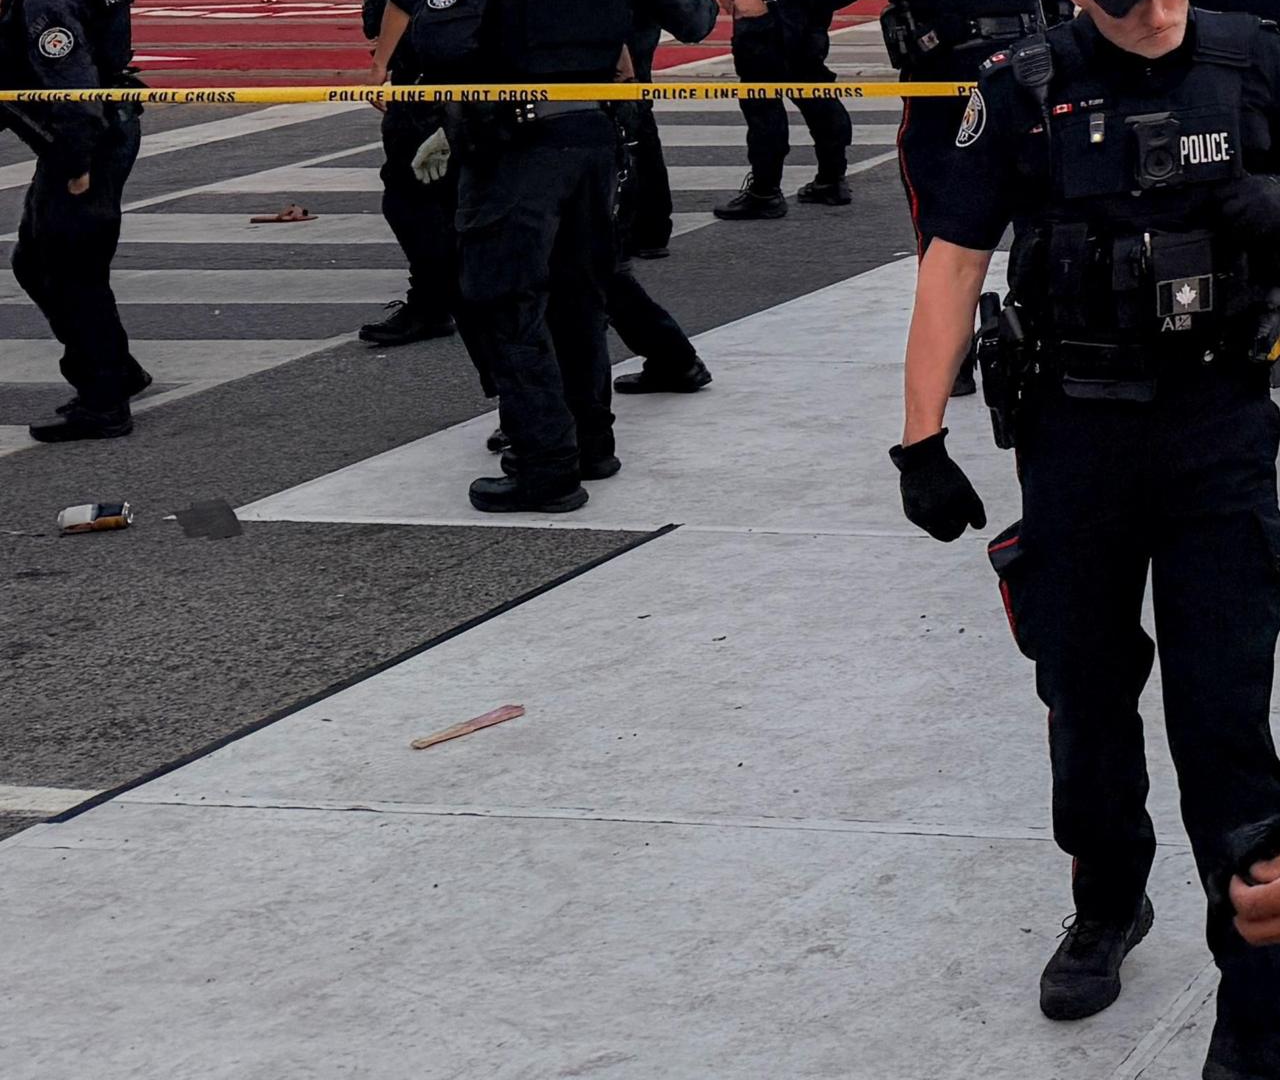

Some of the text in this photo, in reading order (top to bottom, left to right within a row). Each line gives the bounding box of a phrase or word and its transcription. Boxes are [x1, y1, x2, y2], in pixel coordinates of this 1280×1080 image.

[328, 90, 549, 102] POLICE LINE DO NOT CROSS
[642, 88, 697, 100] POLICE
[705, 88, 739, 100] LINE
[775, 88, 805, 100] NOT
[812, 88, 864, 100] CROSS
[1181, 132, 1230, 165] POLICE
